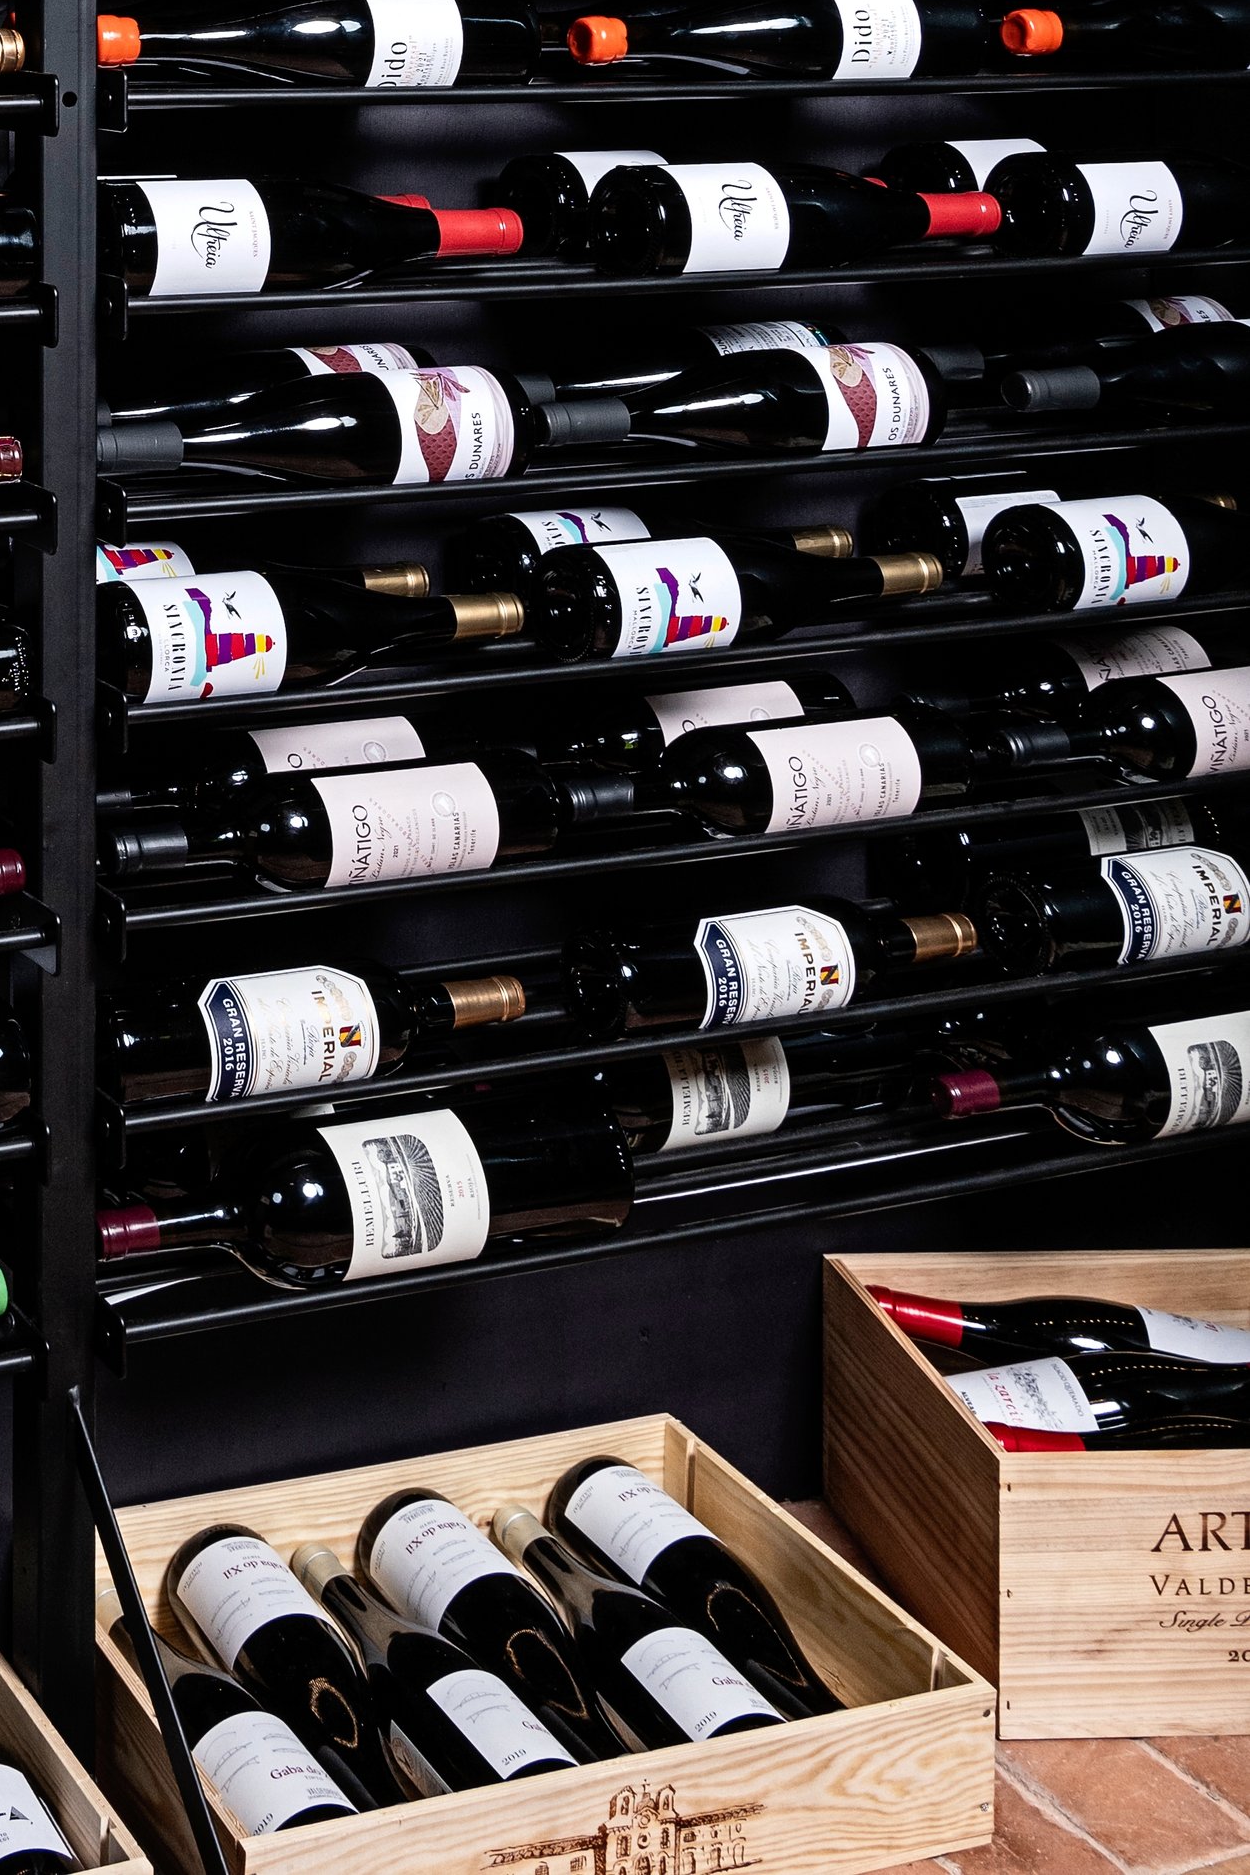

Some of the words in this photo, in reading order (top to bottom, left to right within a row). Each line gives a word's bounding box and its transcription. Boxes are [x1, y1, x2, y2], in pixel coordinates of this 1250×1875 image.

[851, 10, 873, 62] Dido
[883, 367, 901, 423] DUNARES
[471, 412, 482, 470] DUNARES
[888, 426, 899, 441] OS
[349, 804, 372, 882] IÑÁTIGO
[1121, 871, 1148, 906] GRAN
[1136, 908, 1152, 959] RESERVA
[1130, 904, 1142, 933] 2016
[1191, 865, 1221, 946] IMPERIAL
[716, 939, 731, 977] GRAN
[717, 977, 727, 1006] 2016
[222, 998, 243, 1039] GRAN
[223, 1038, 235, 1071] 2016
[229, 1042, 248, 1097] RESERVA
[352, 1161, 376, 1246] REMELLURI
[405, 1534, 423, 1555] Xil
[422, 1526, 436, 1538] do
[270, 1766, 303, 1780] Gaba
